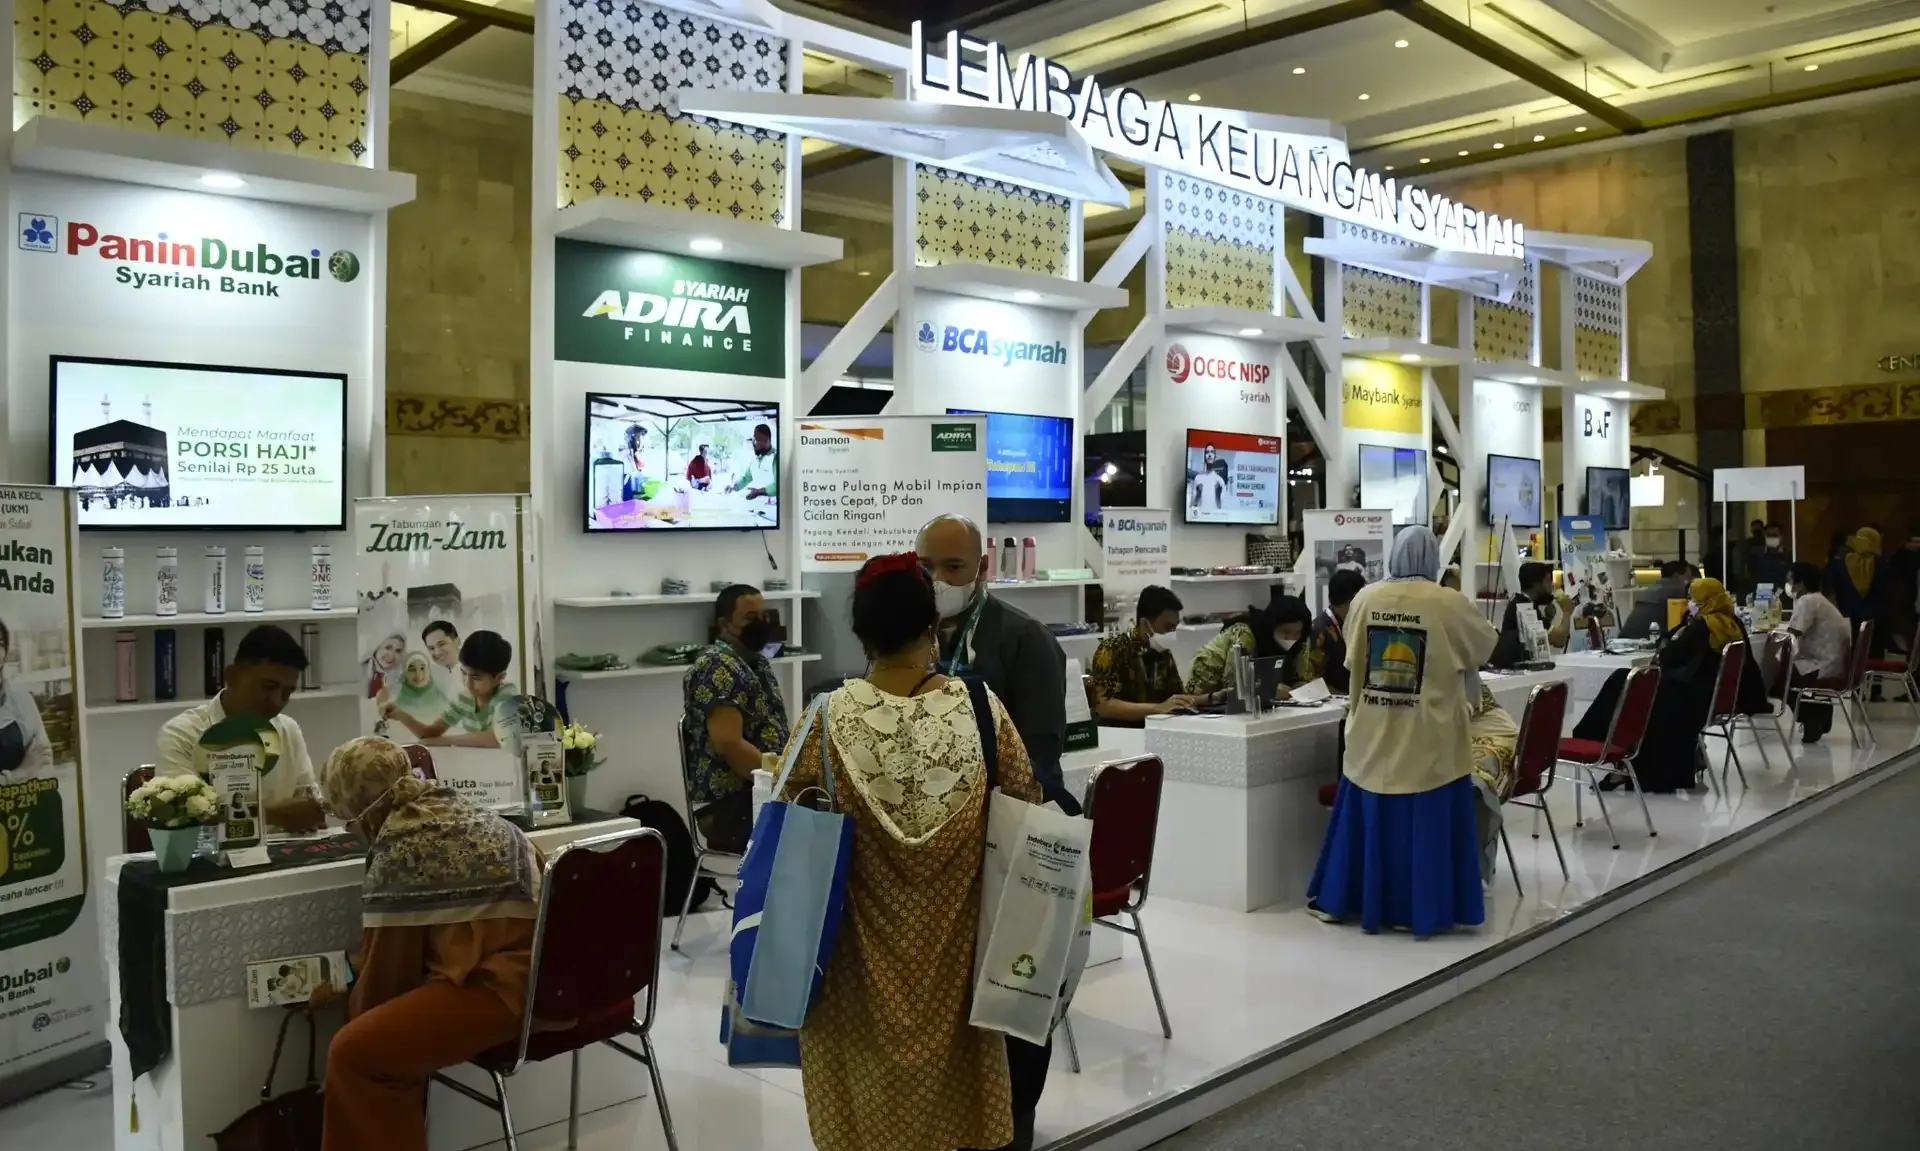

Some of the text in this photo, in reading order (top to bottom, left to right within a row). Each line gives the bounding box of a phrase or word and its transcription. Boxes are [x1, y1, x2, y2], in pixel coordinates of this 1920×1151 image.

[912, 19, 1525, 260] LEMBAGA KEUANGAN SYARIAH
[116, 266, 279, 297] Syariah Bank
[673, 279, 750, 303] SYARIAH
[582, 289, 751, 335] ADIRA
[624, 327, 752, 352] FINANCE
[1194, 356, 1270, 384] OCBC NISP
[1240, 390, 1270, 403] Syariah
[1352, 384, 1400, 405] Maybank
[177, 426, 315, 442] Mendapat Manfaat
[801, 435, 850, 446] Danamon
[936, 432, 972, 440] ADIRA
[177, 440, 248, 458] PORSI
[177, 460, 316, 476] Senilai Rp 25 Juta
[802, 479, 983, 494] Bawa Pulang Mobil Impian
[18, 490, 44, 501] KECIL
[803, 493, 923, 509] Proses Cepat, DP dan
[1, 503, 29, 515] (UKM)
[803, 509, 886, 523] Cicilan Ringan!
[391, 519, 442, 530] Tabungan
[1345, 516, 1366, 524] OCBC
[365, 521, 507, 553] Zam-Zam
[851, 539, 883, 548] dengan
[0, 569, 54, 595] Anda
[1371, 611, 1380, 620] TO
[24, 882, 53, 897] lancar
[8, 985, 36, 1001] Bank
